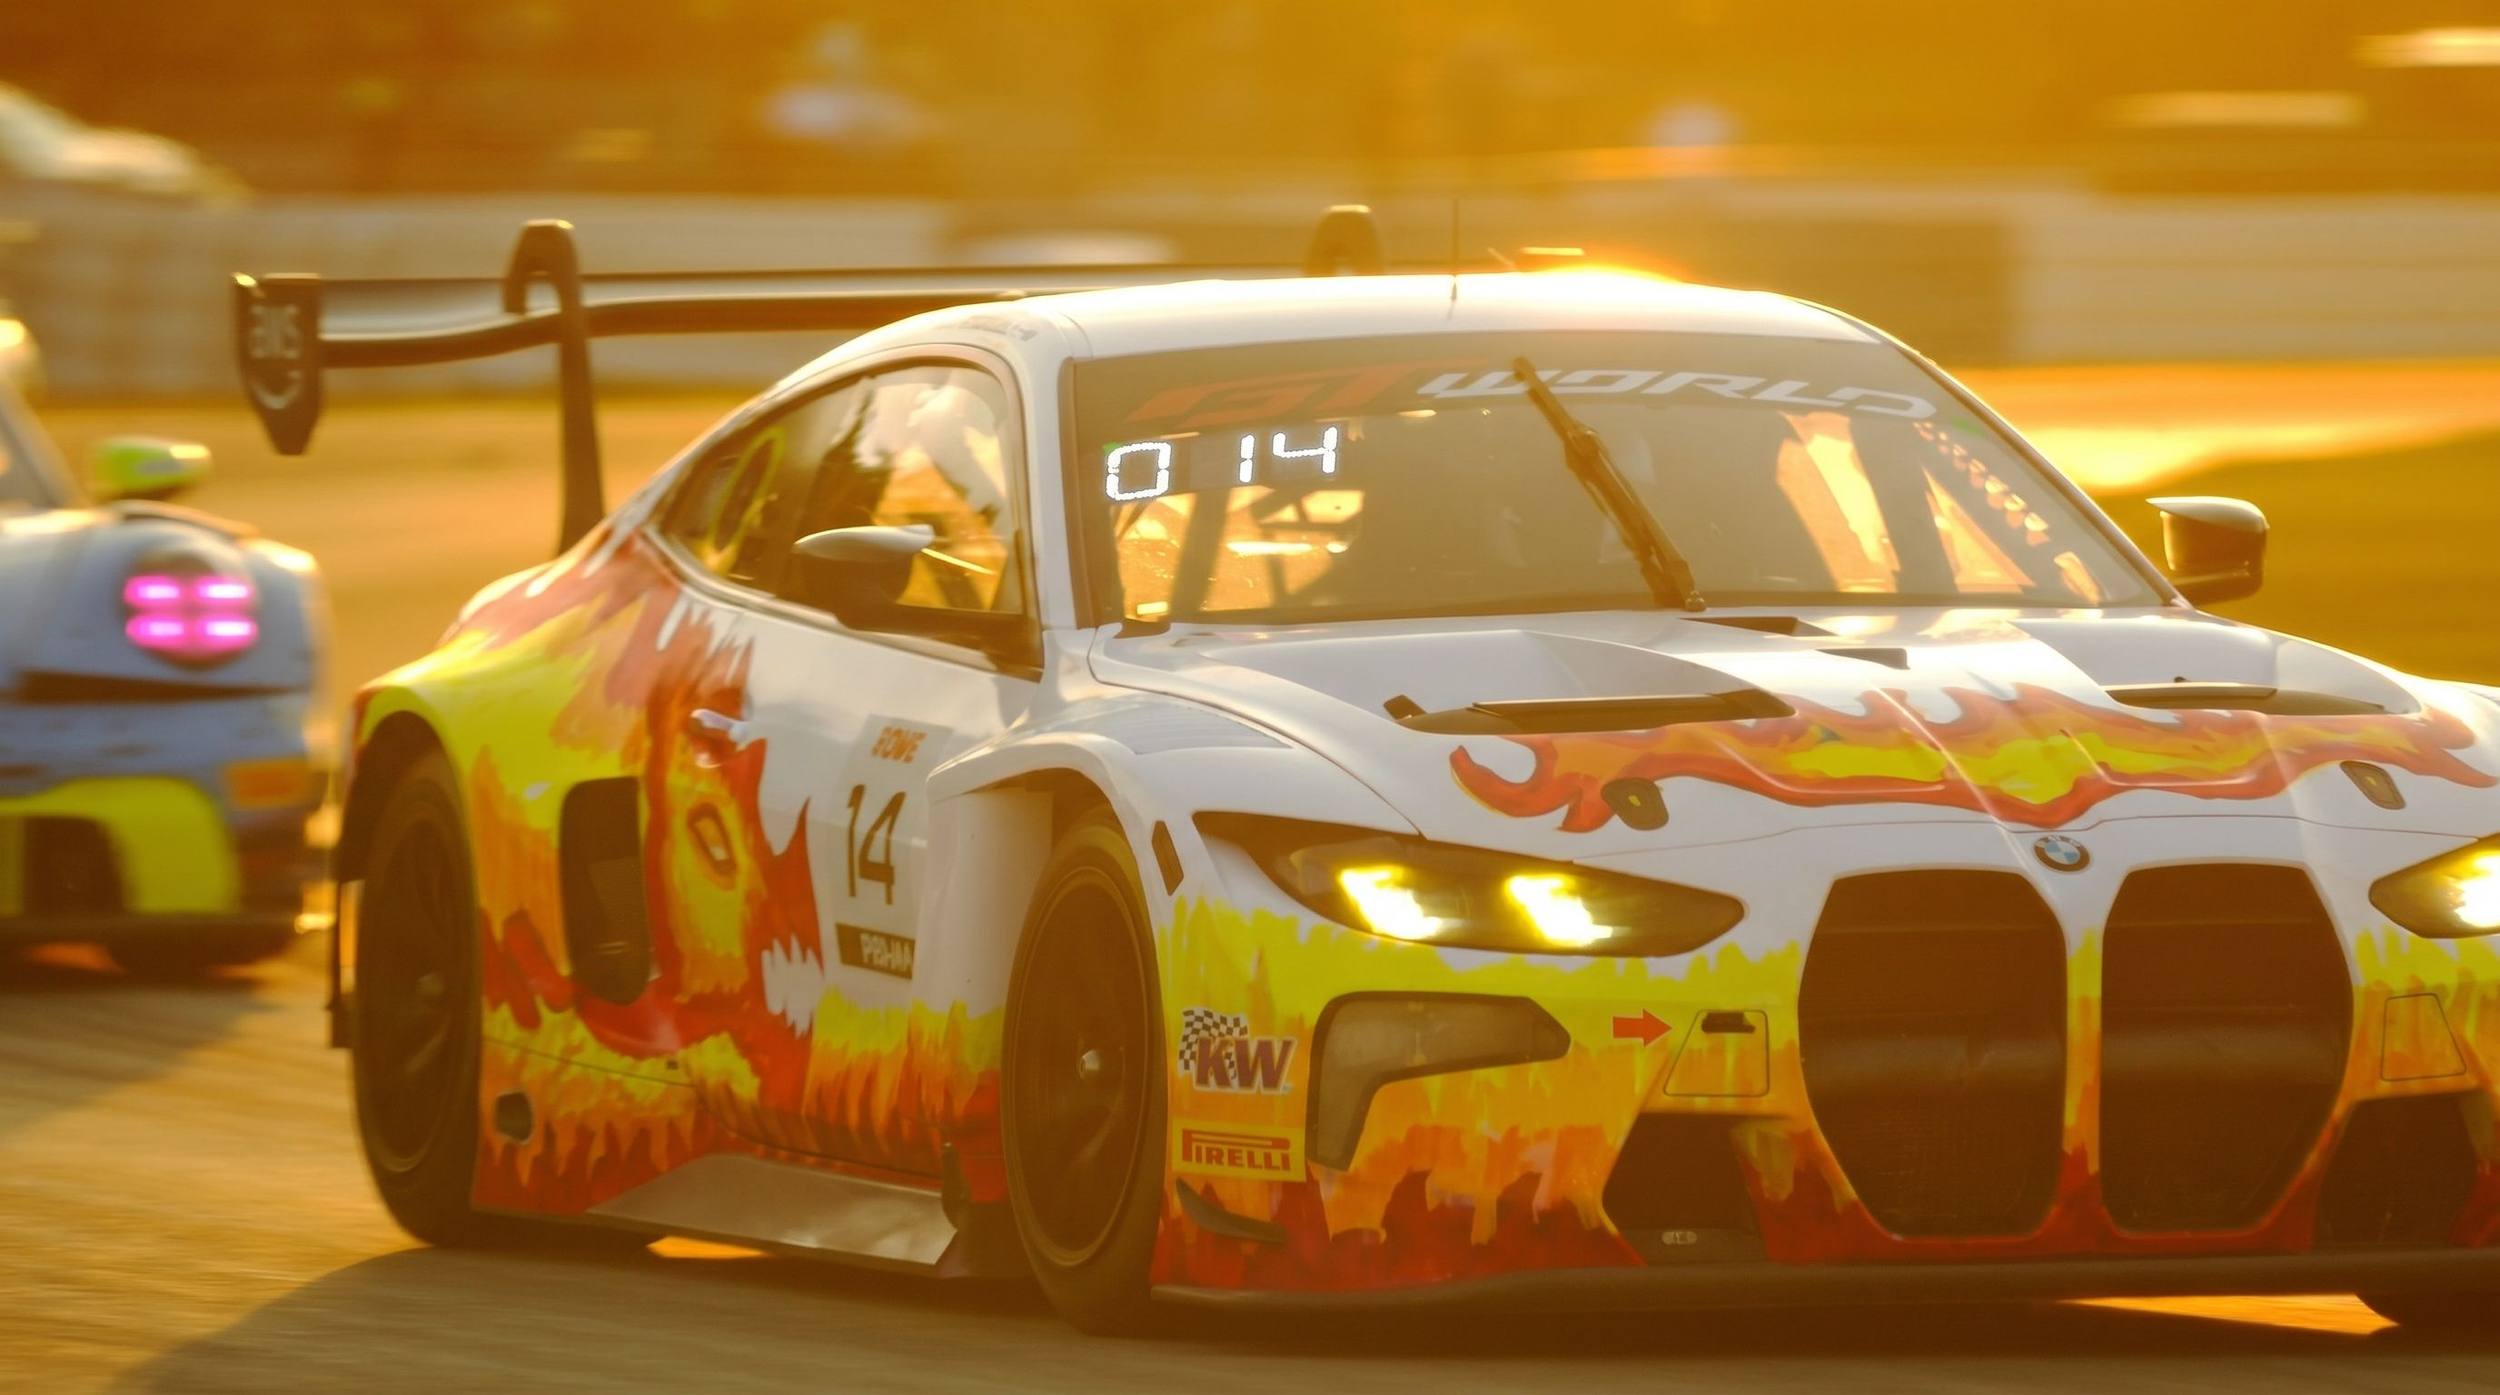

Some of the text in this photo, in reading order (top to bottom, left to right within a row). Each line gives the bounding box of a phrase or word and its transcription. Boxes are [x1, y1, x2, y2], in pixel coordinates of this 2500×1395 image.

[1127, 358, 1938, 427] GT WORLD
[847, 784, 907, 906] 14
[1195, 1038, 1296, 1092] KW
[1182, 1128, 1291, 1171] PIRELLI
